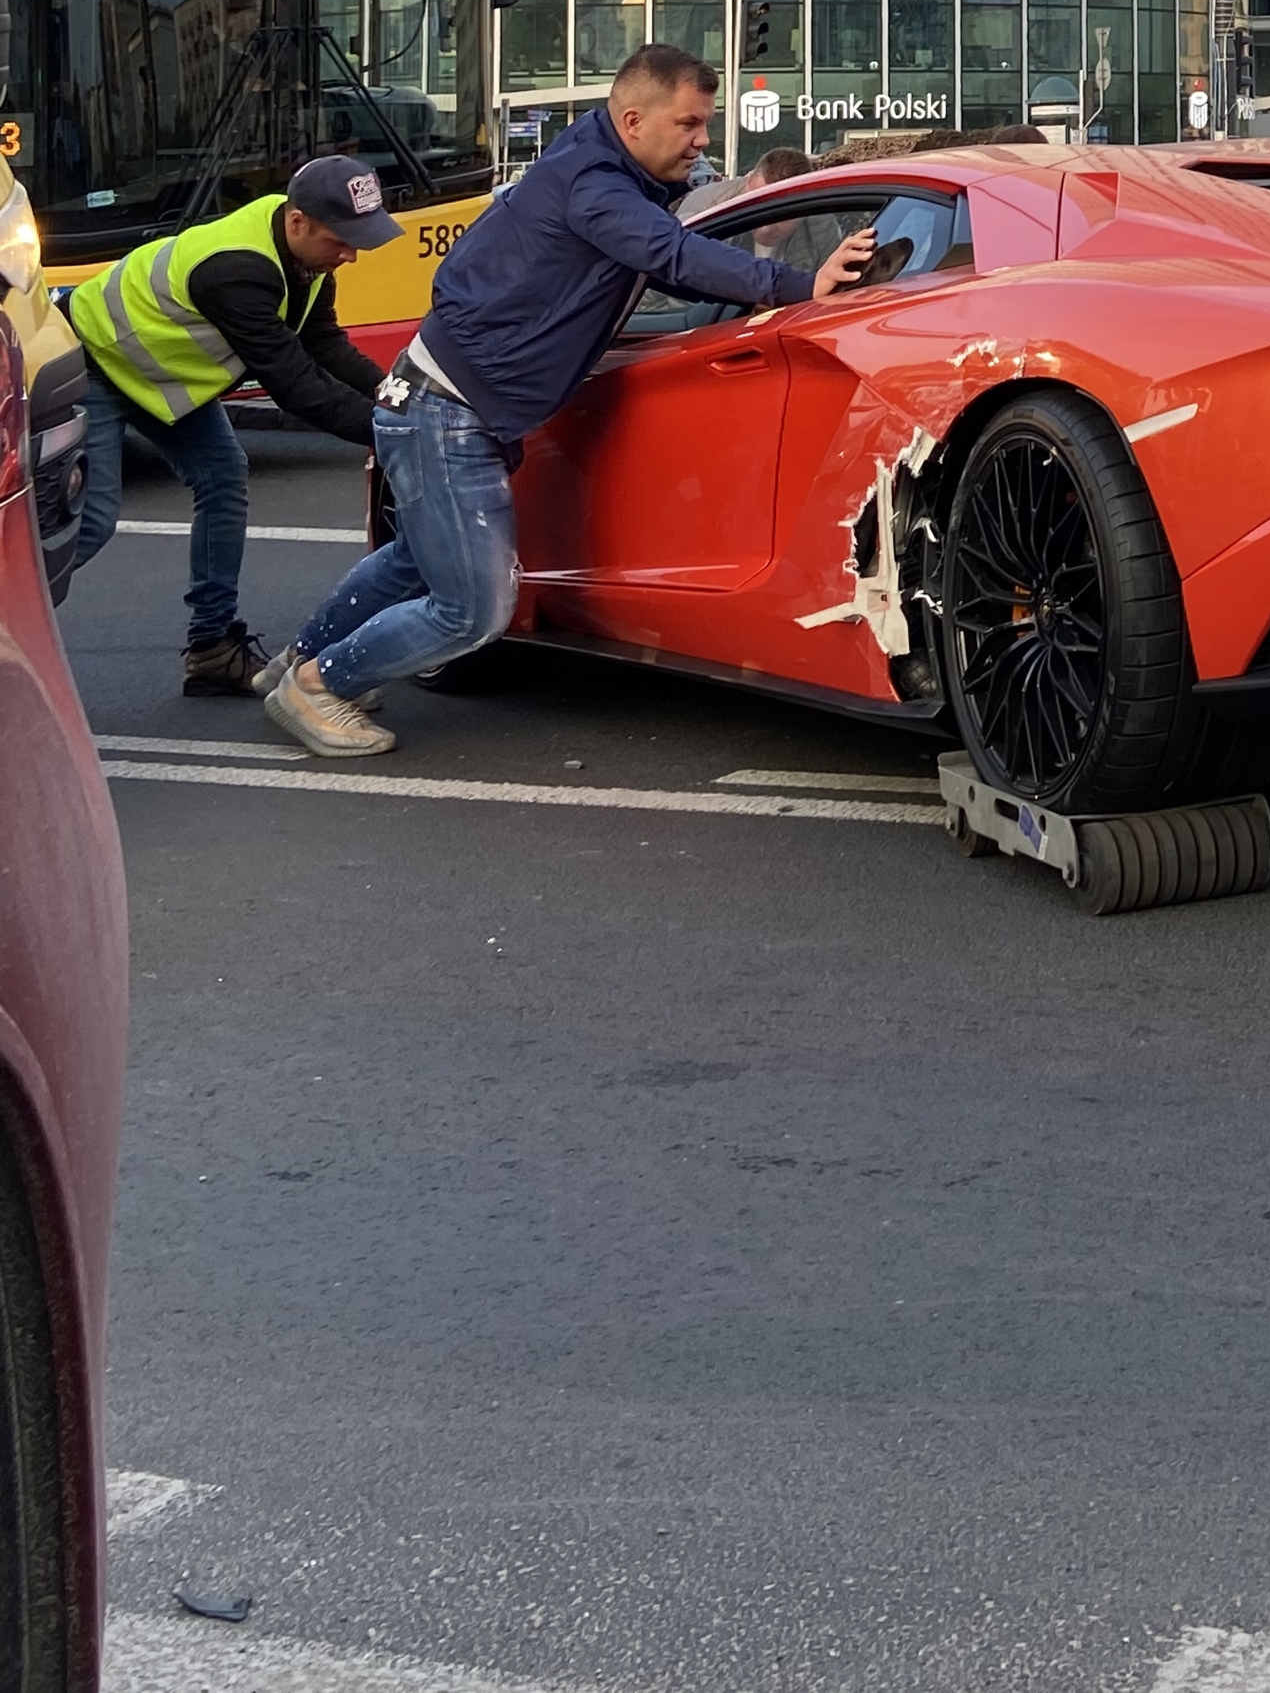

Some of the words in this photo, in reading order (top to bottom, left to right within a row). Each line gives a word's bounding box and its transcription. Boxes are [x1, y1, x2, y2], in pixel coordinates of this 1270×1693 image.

[740, 90, 780, 133] PKO
[797, 93, 864, 120] Bank
[875, 93, 947, 120] Polski
[418, 223, 471, 259] 588
